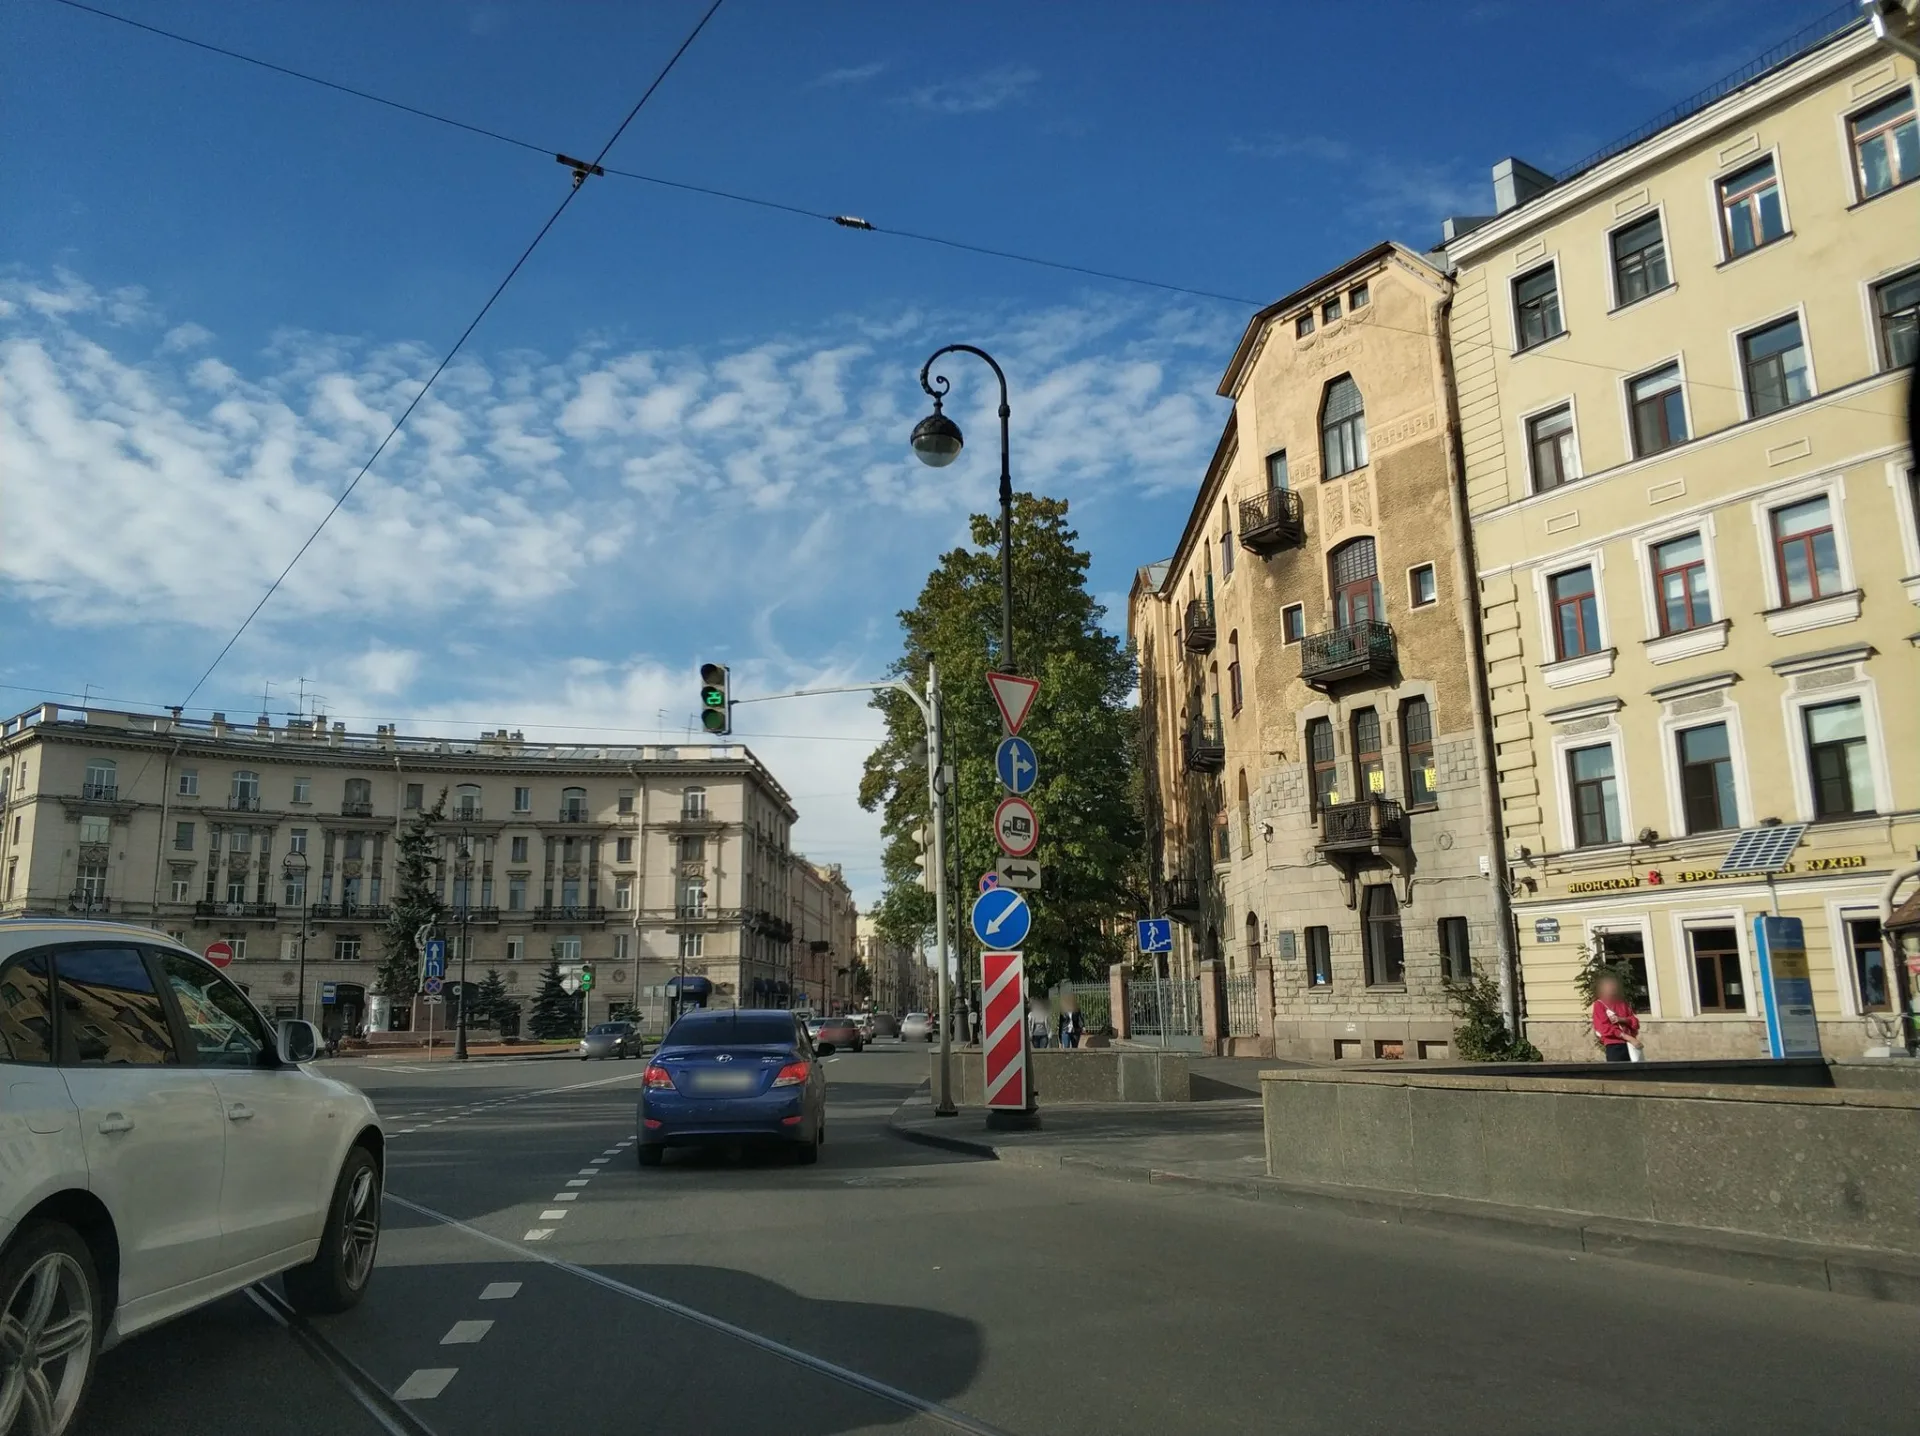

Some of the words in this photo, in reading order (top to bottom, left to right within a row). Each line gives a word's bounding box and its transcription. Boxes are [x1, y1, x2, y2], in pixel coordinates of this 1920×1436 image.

[1568, 877, 1638, 894] ЯПОНСКАЯ
[1648, 870, 1662, 886] &
[1805, 856, 1864, 871] КУХНЯ
